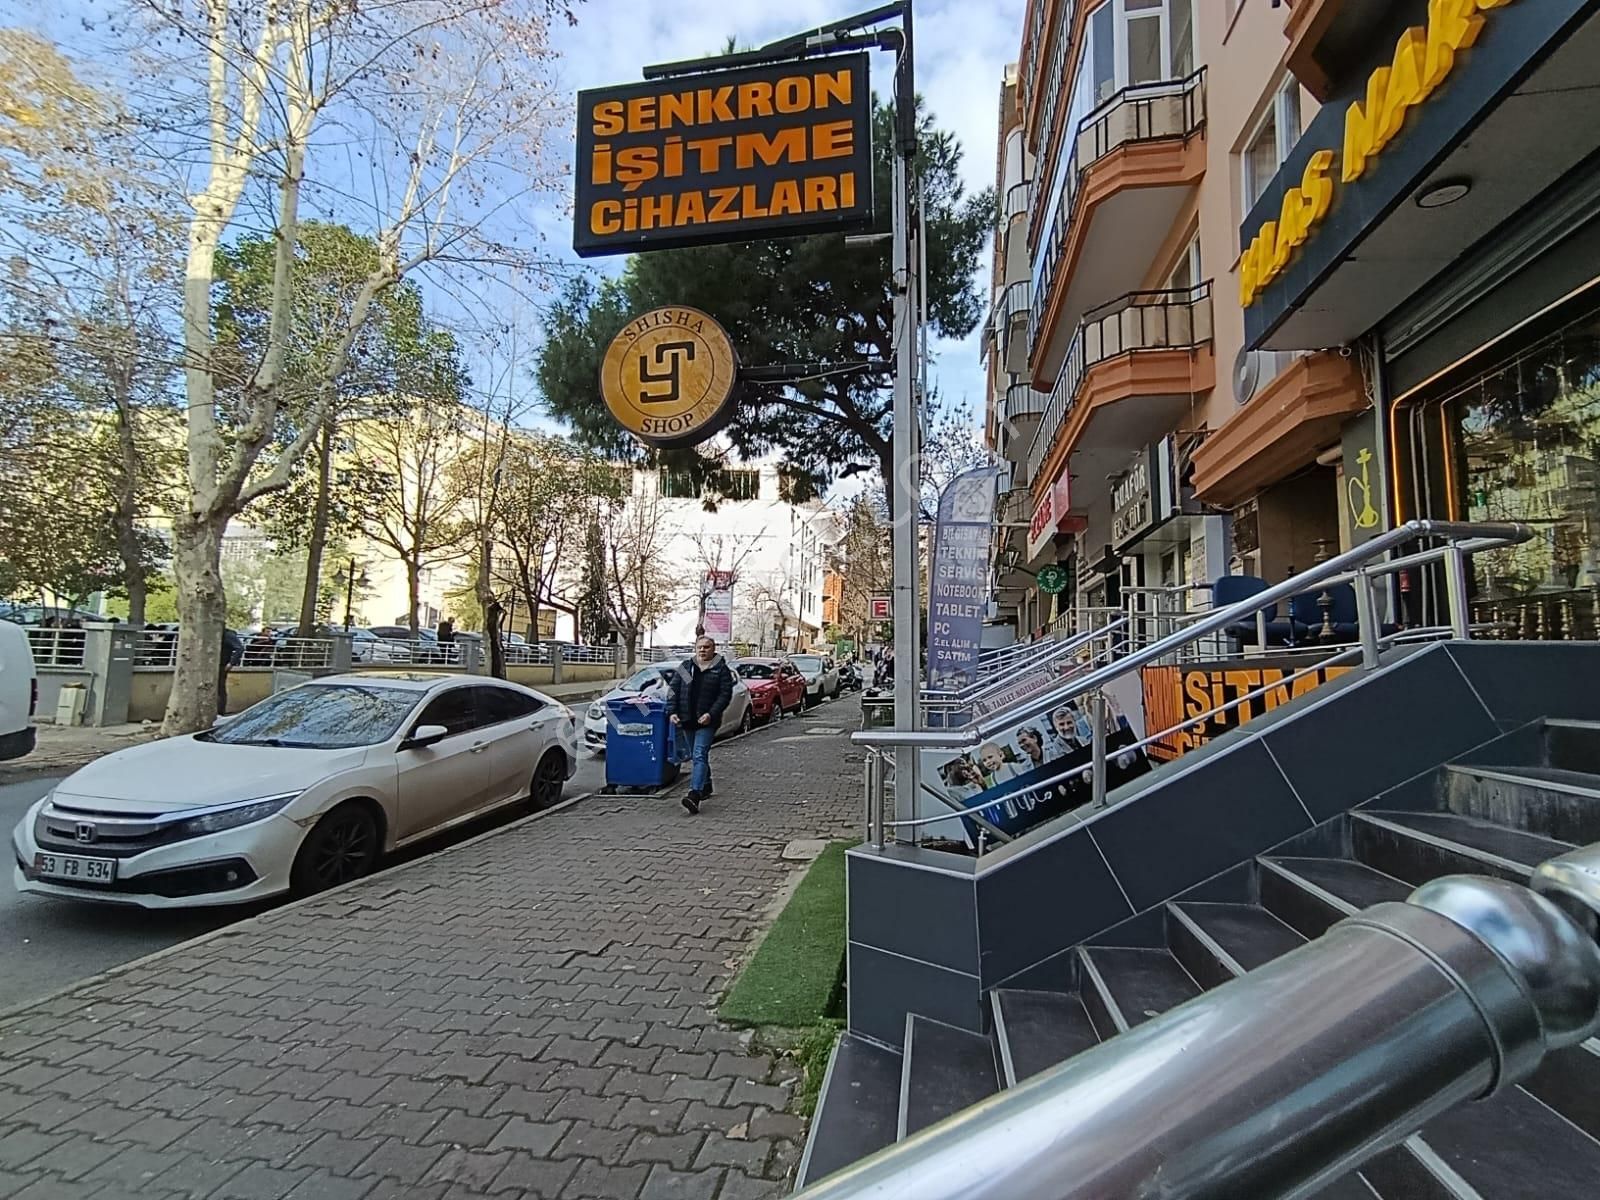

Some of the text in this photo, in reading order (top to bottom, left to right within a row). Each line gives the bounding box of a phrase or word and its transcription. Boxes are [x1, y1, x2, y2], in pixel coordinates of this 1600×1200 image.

[592, 69, 852, 137] SENKRON
[592, 119, 854, 192] İŞİTME
[590, 172, 855, 235] CİHAZLARI
[624, 311, 704, 341] SHISHA
[641, 413, 693, 433] SHOP
[935, 602, 981, 618] TABLET
[934, 621, 950, 635] PC
[937, 650, 971, 661] SATIM
[41, 855, 109, 879] 53 FB 534
